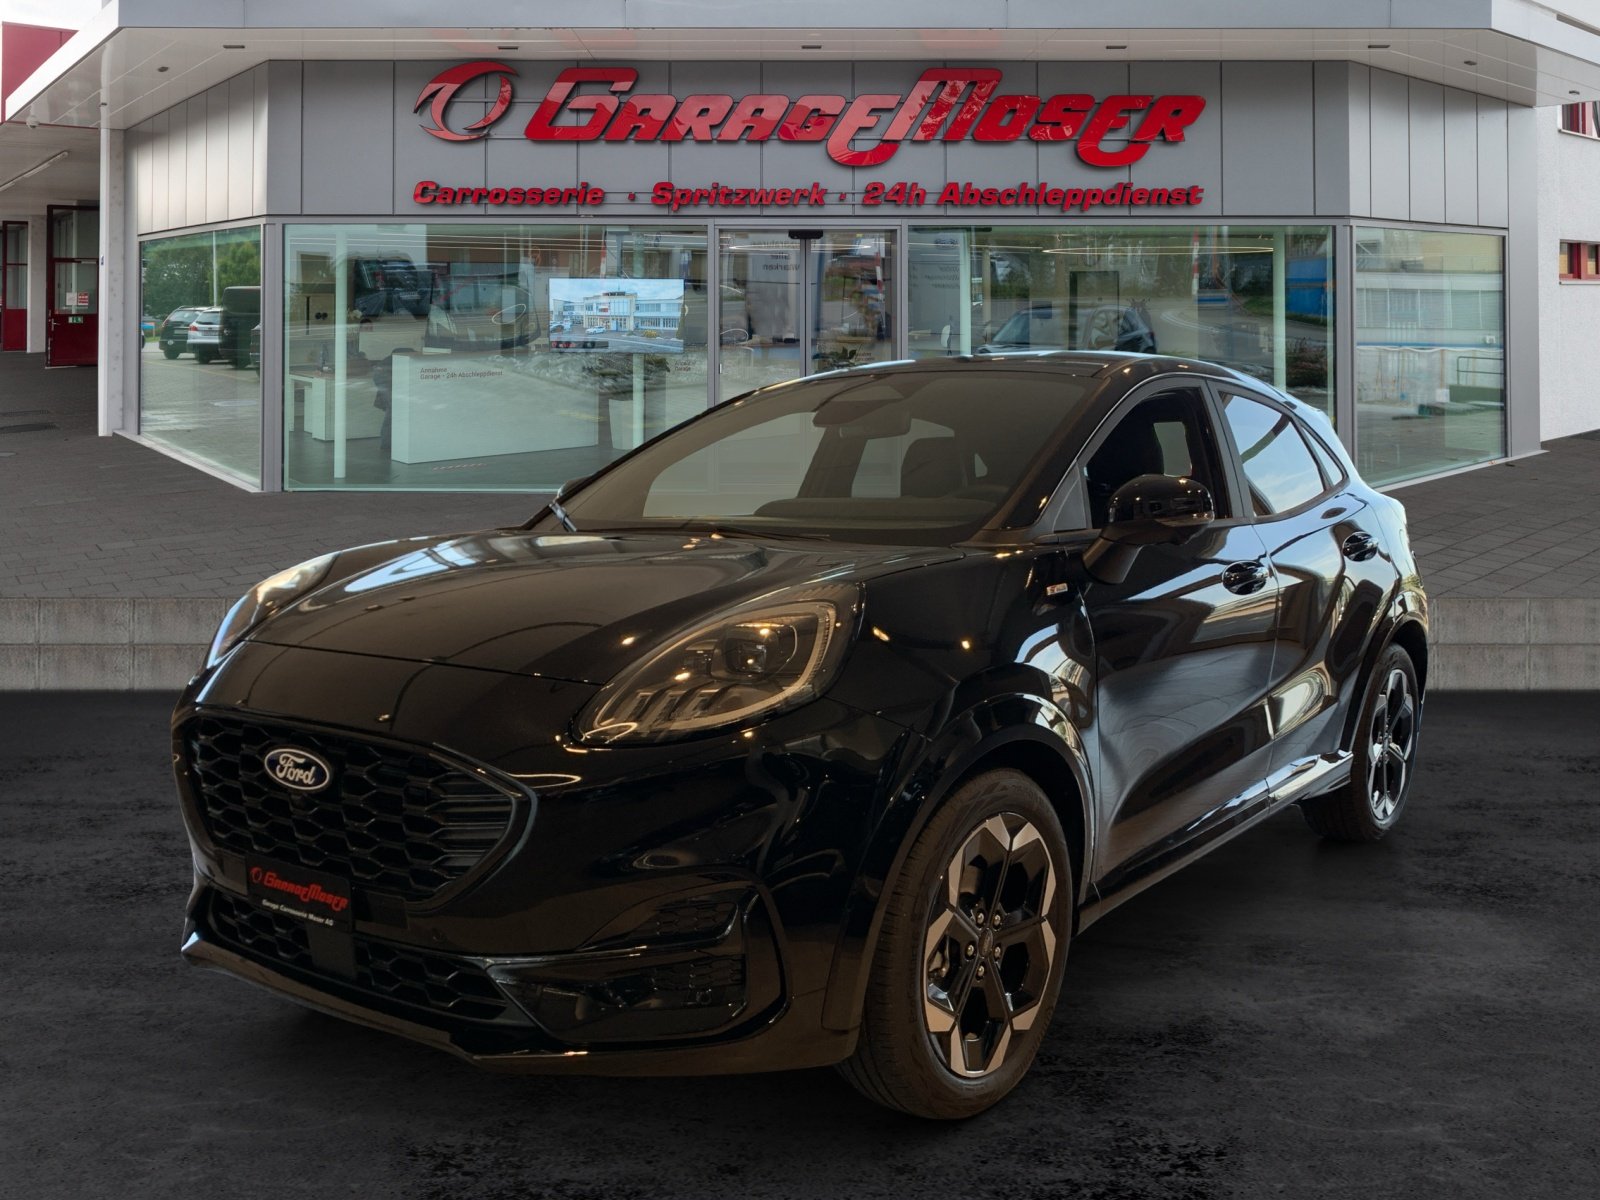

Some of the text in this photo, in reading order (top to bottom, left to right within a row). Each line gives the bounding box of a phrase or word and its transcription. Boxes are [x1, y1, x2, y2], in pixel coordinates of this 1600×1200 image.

[413, 180, 1205, 212] Carrosserie Spritzwerk 24h Abschleppdienst
[276, 753, 316, 785] Ford
